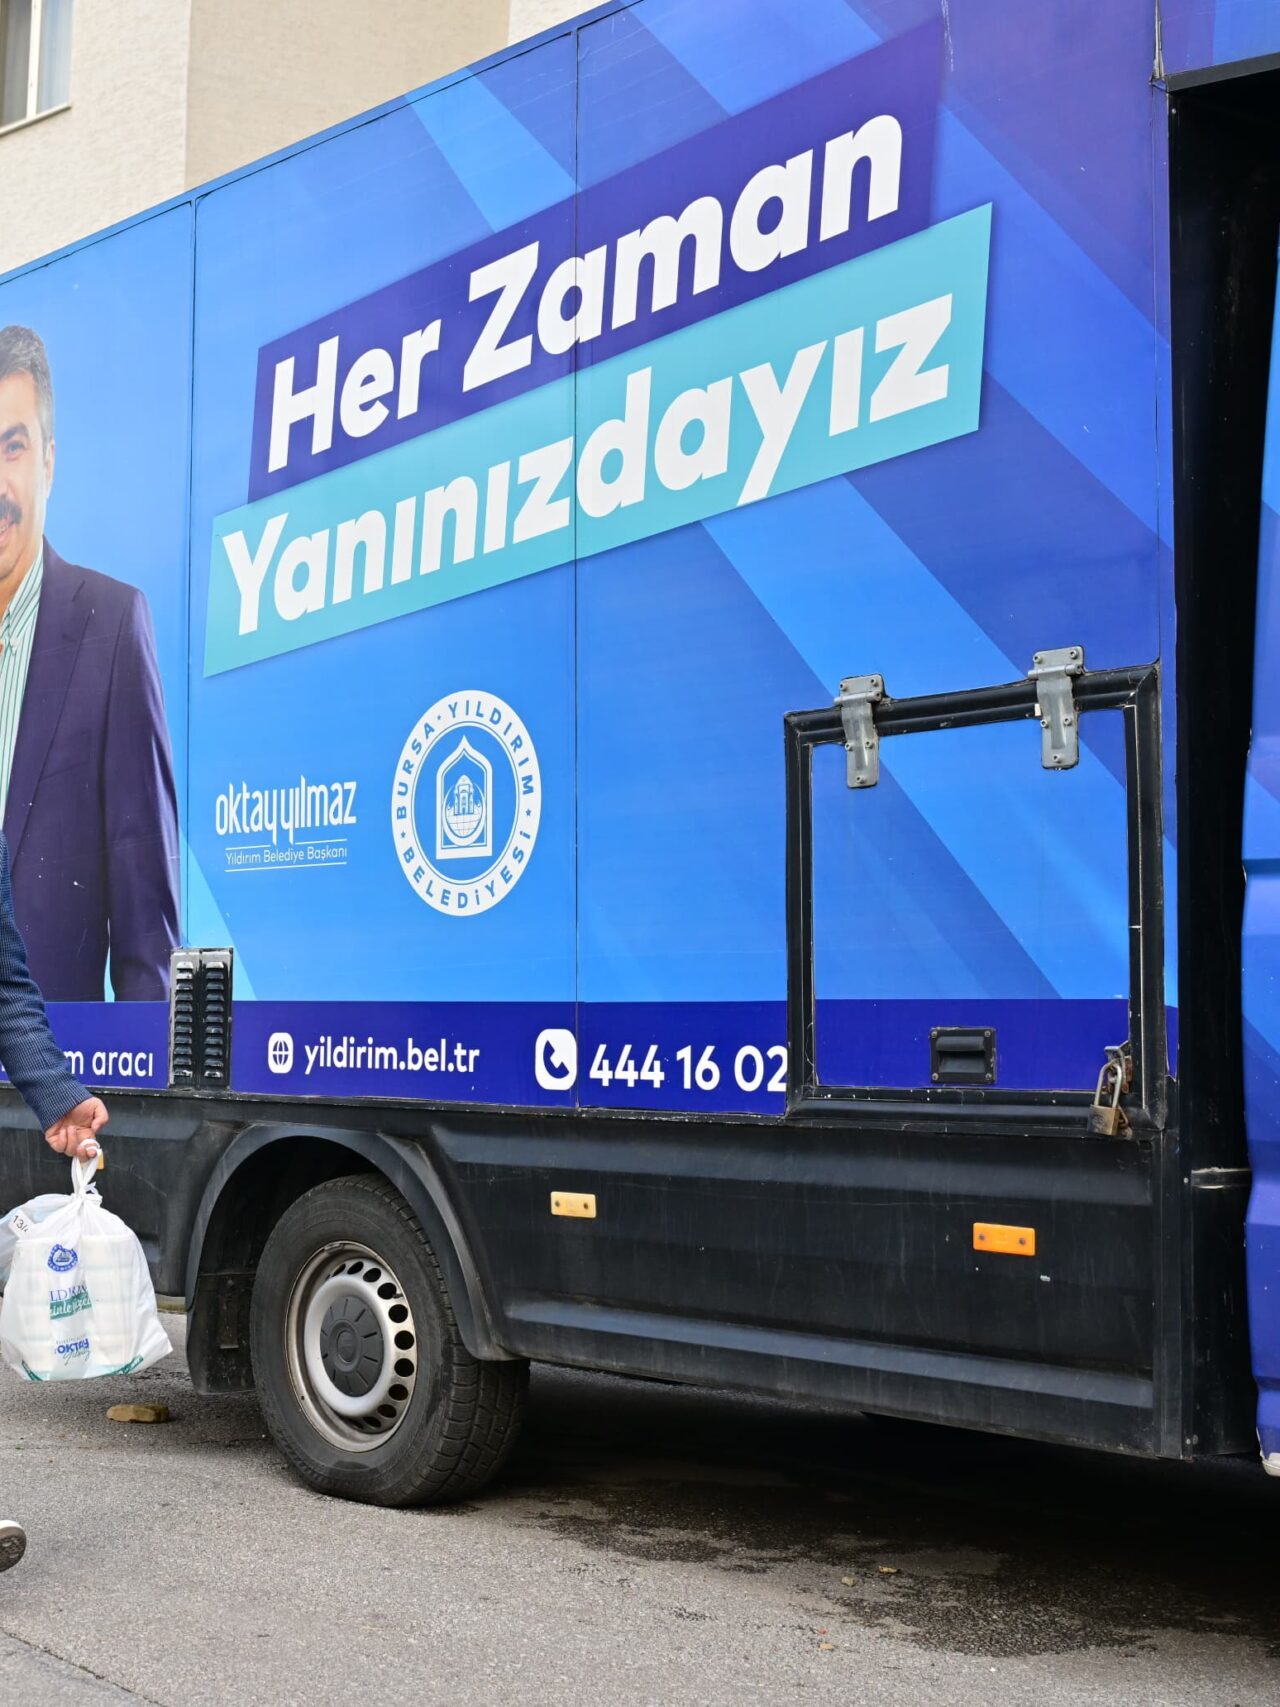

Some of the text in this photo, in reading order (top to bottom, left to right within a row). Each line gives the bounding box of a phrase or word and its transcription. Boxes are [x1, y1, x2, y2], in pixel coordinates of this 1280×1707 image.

[267, 114, 903, 473] Her Zaman
[222, 293, 953, 636] Yanınızdayız
[396, 724, 436, 821] BURSA
[447, 698, 536, 796] YILDIRIM
[225, 846, 348, 865] Yıldırım Belediye Başkanı
[403, 829, 532, 910] BELEDİYESİ
[92, 1051, 153, 1077] aracı
[304, 1036, 480, 1075] yildirim.bel.tr
[589, 1043, 787, 1092] 444 16 02
[57, 1338, 90, 1354] OKTAY
